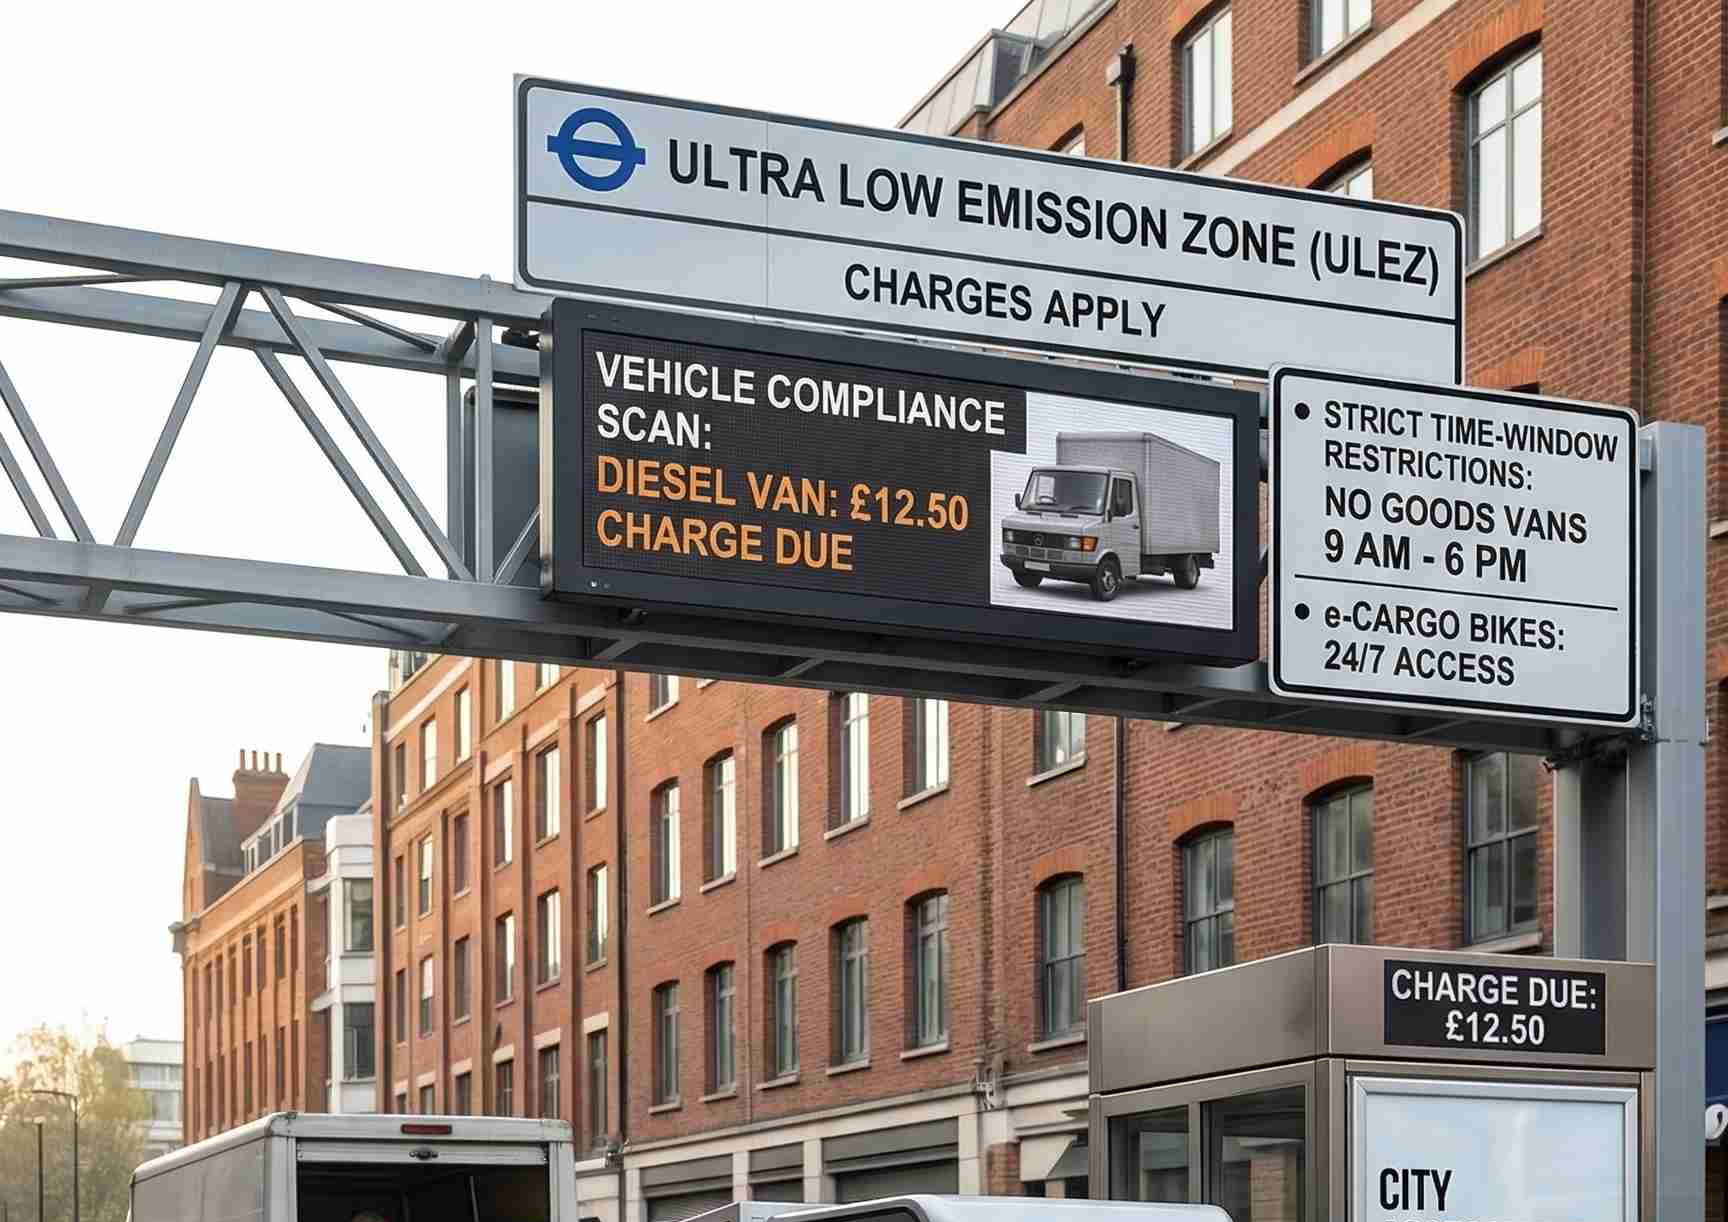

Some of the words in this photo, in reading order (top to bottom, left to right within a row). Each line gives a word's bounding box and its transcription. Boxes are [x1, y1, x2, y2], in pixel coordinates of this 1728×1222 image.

[668, 139, 825, 202] ULTRA
[839, 163, 943, 218] LOW
[958, 180, 1168, 250] EMISSION
[1182, 212, 1296, 267] ZONE
[1310, 230, 1439, 296] (ULEZ)
[844, 263, 1033, 322] CHARGES
[1044, 289, 1166, 338] APPLY
[596, 351, 756, 405] VEHICLE
[767, 374, 1006, 435] COMPLIANCE
[597, 403, 712, 450] SCAN:
[1324, 400, 1423, 438] STRICT
[1430, 412, 1618, 462] TIME-WINDOW
[1325, 440, 1533, 490] RESTRICTIONS:
[597, 455, 737, 506] DIESEL
[747, 471, 838, 518] VAN:
[850, 483, 970, 531] £12.50
[1325, 486, 1371, 520] NO
[1381, 492, 1495, 534] GOODS
[1504, 505, 1588, 544] VANS
[597, 510, 763, 562] CHARGE
[776, 527, 854, 571] DUE
[1324, 528, 1344, 563] 9
[1354, 532, 1411, 570] AM
[1444, 541, 1464, 576] 6
[1476, 544, 1527, 583] PM
[1324, 600, 1460, 640] e-CARGO
[1470, 613, 1565, 651] BIKES:
[1324, 640, 1385, 675] 24/7
[1393, 646, 1515, 686] ACCESS
[1391, 968, 1519, 1006] CHARGE
[1528, 977, 1598, 1010] DUE:
[1445, 1010, 1546, 1046] £12.50
[1379, 1168, 1452, 1211] CITY
